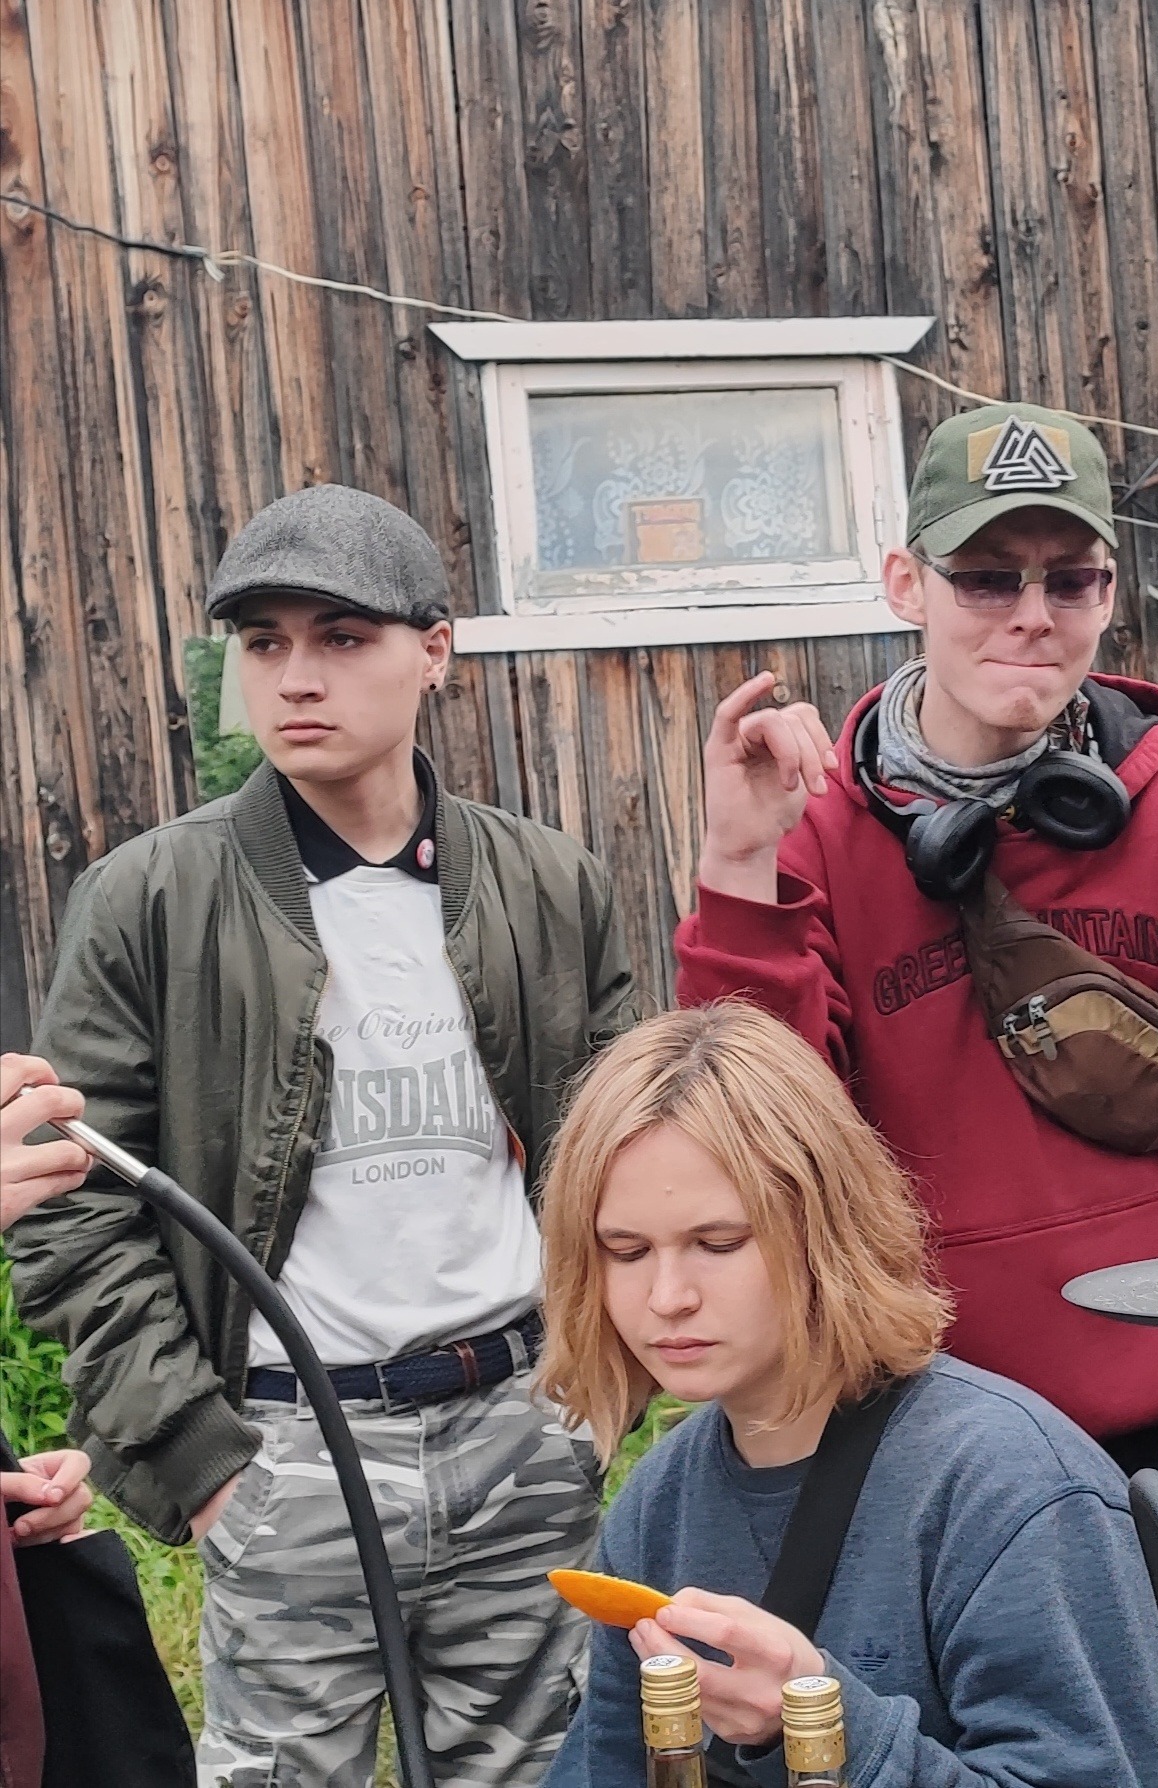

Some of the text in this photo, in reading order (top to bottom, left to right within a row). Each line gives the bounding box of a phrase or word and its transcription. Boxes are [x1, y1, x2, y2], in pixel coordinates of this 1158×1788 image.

[873, 933, 969, 1016] GREE
[357, 1008, 470, 1050] Origina
[321, 1049, 493, 1151] NSDALE
[351, 1156, 446, 1184] LONDON
